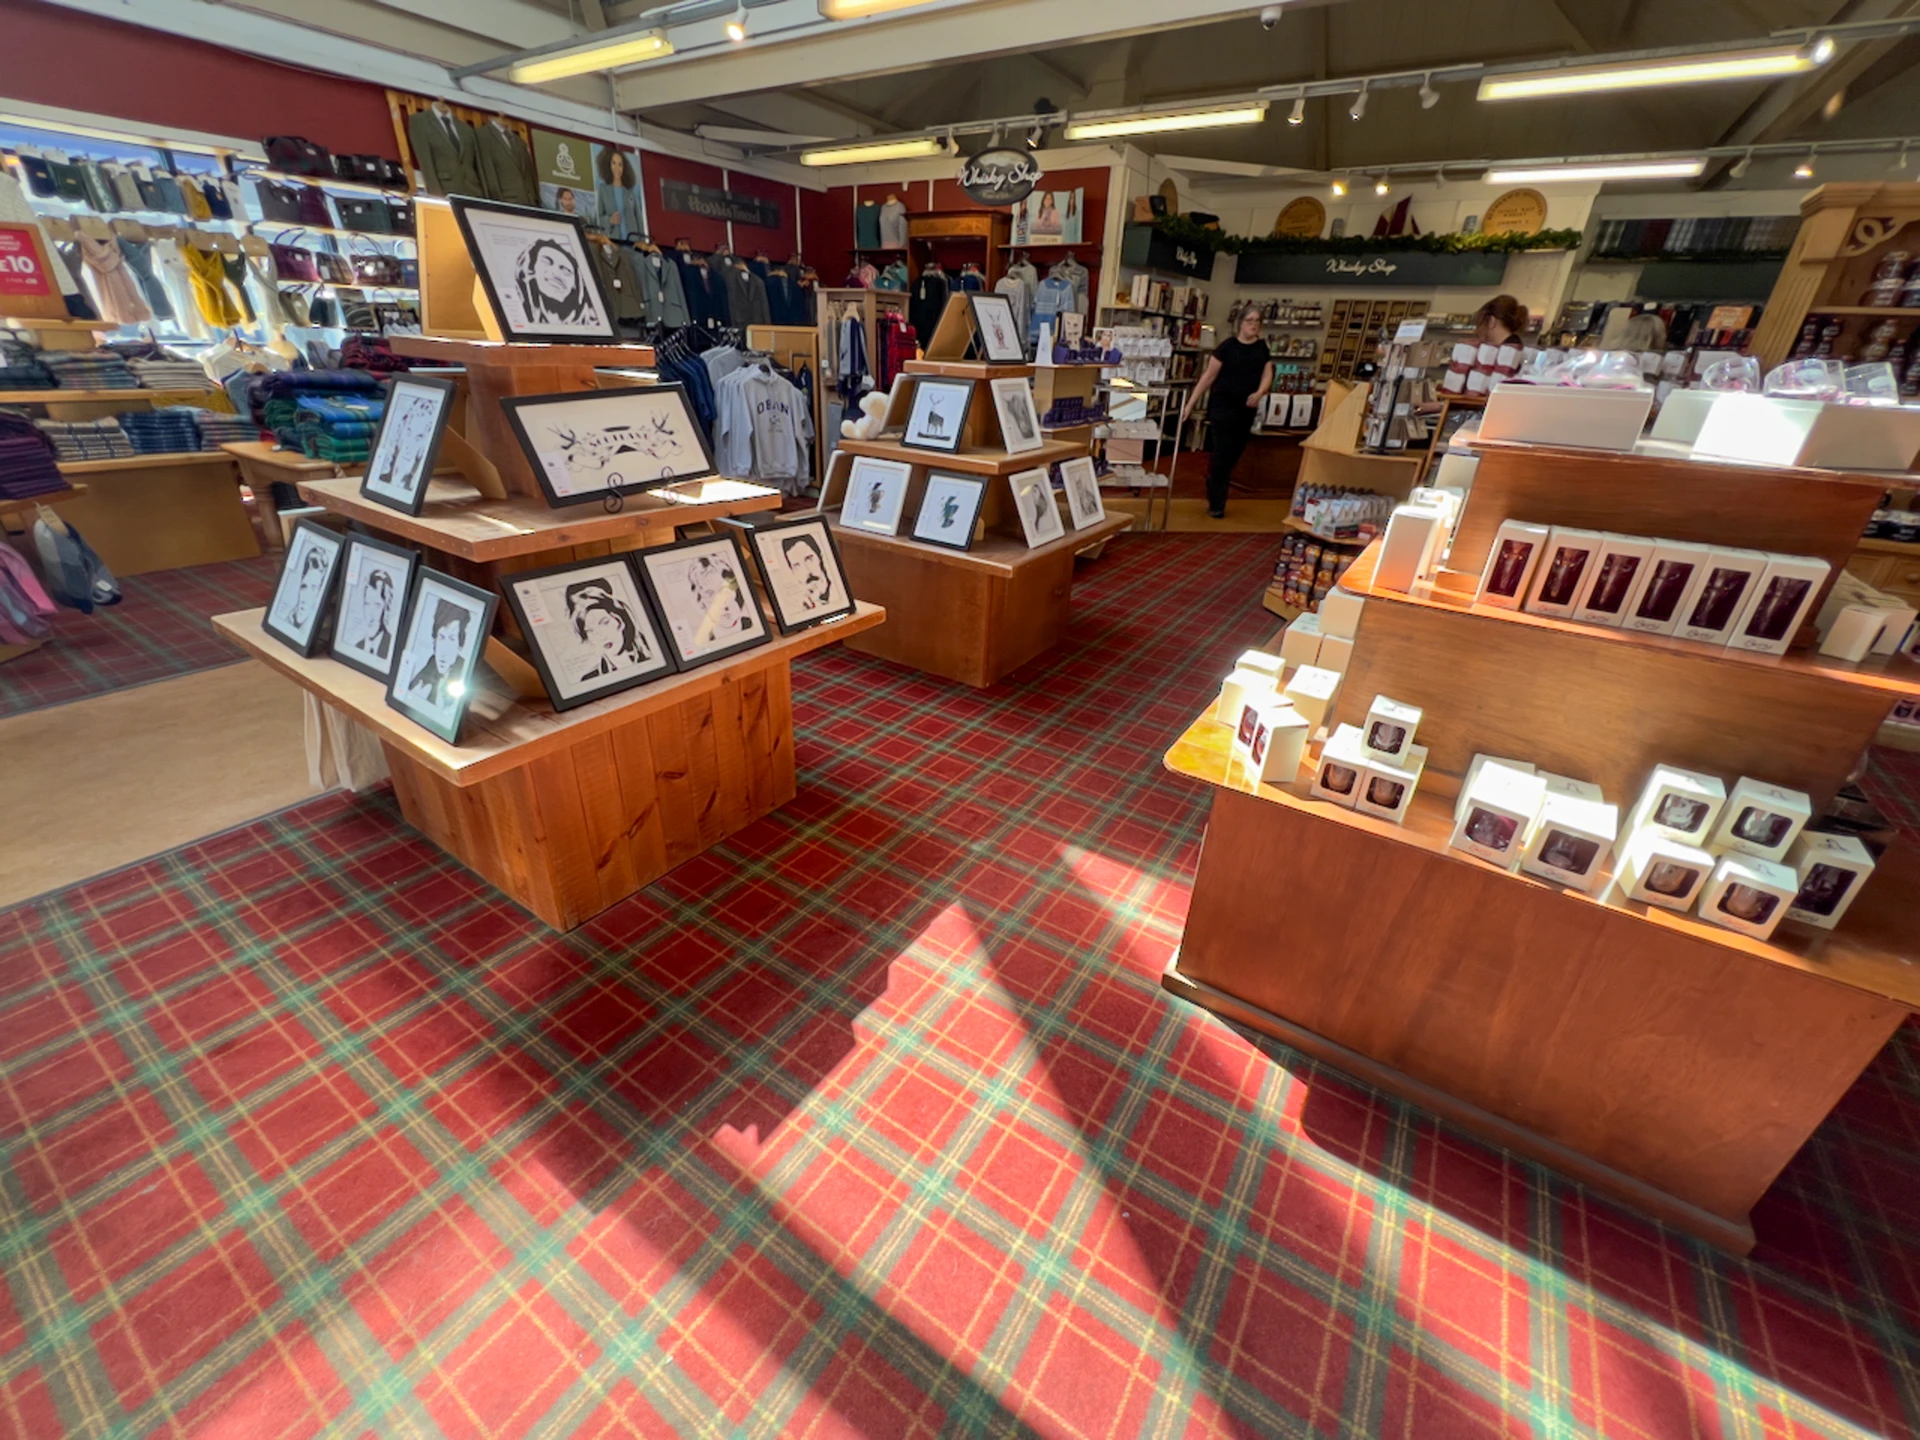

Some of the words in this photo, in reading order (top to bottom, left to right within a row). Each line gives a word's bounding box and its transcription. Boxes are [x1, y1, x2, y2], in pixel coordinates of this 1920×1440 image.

[957, 166, 1006, 191] Whisky
[1008, 162, 1044, 188] Shop
[1325, 258, 1367, 277] Whisky
[1368, 257, 1398, 277] Shop
[757, 398, 790, 416] OBAN
